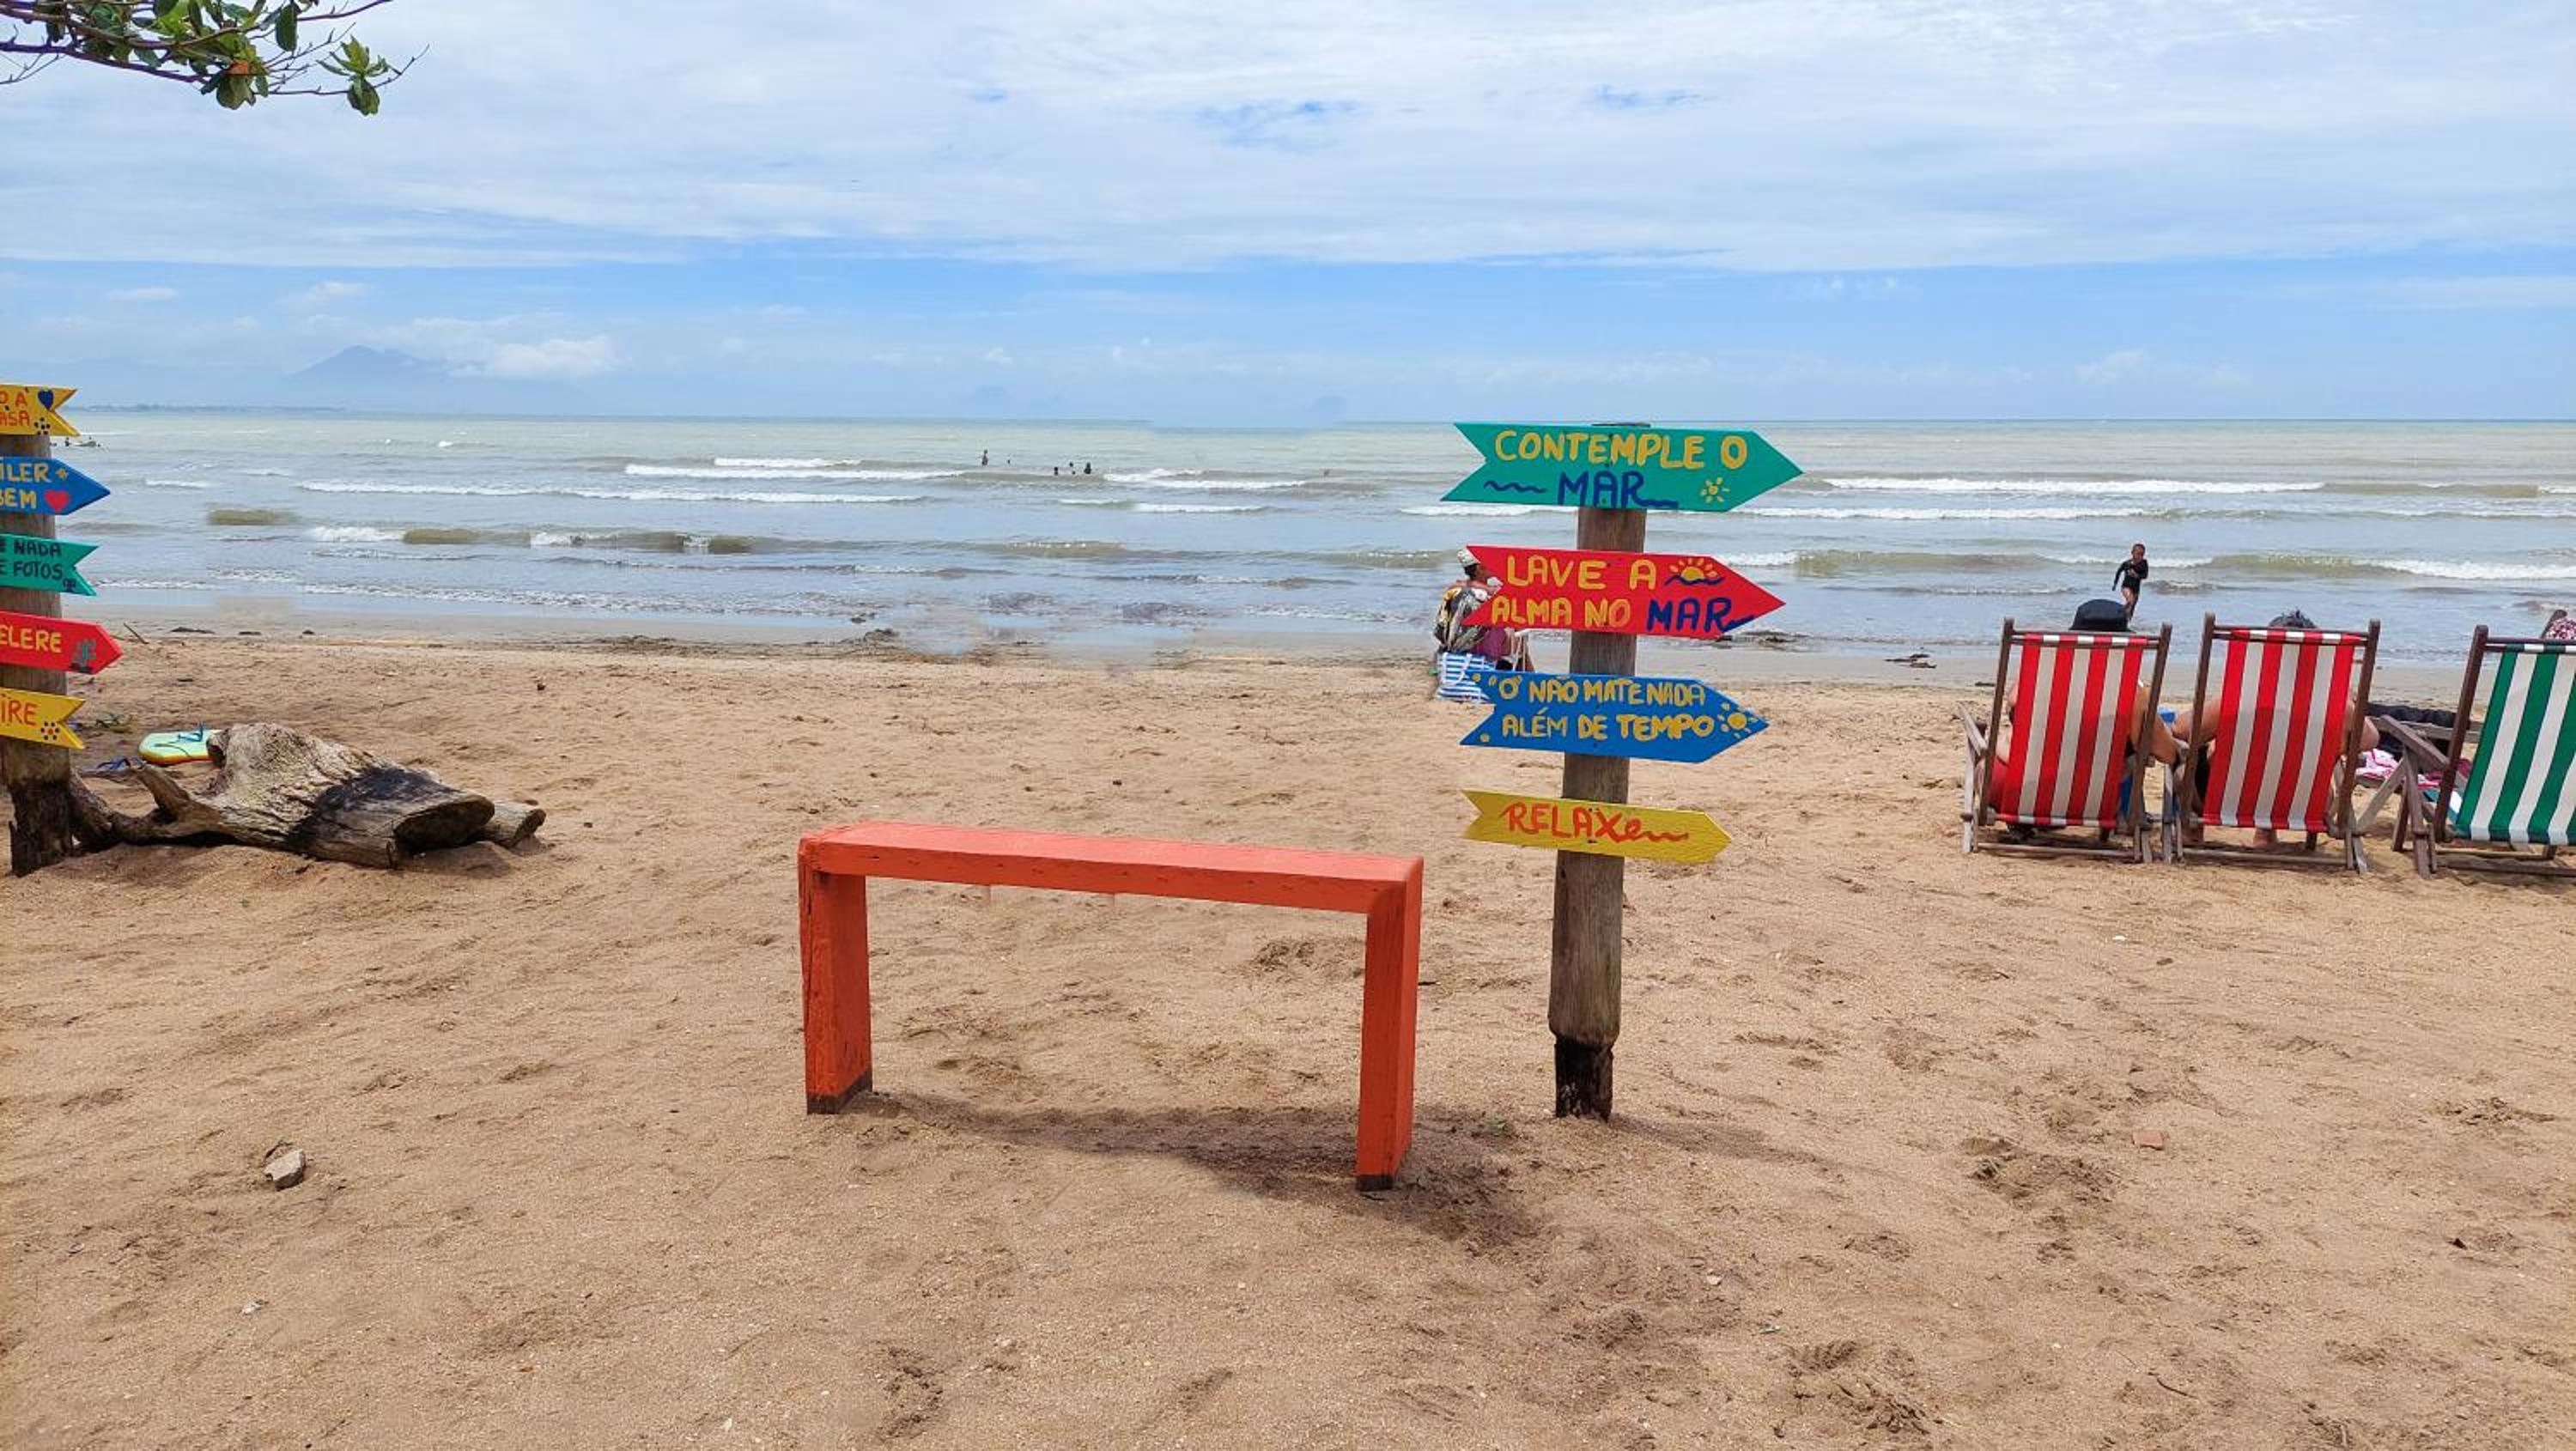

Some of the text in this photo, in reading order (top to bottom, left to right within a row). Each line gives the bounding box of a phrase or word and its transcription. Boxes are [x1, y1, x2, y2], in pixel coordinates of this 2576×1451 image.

[1495, 430, 1748, 470] CONTEMPLE O
[1557, 470, 1678, 508] MAR
[14, 538, 62, 557] NADA
[13, 561, 63, 581] FOTOS
[1507, 555, 1656, 591] LAVE A
[1491, 596, 1754, 634] ALMA NO MAR
[1528, 675, 1579, 703] NÃO
[1583, 677, 1644, 705] MATE
[1646, 682, 1706, 707] NADA
[1501, 707, 1715, 742] ALÉM DE TEMPO
